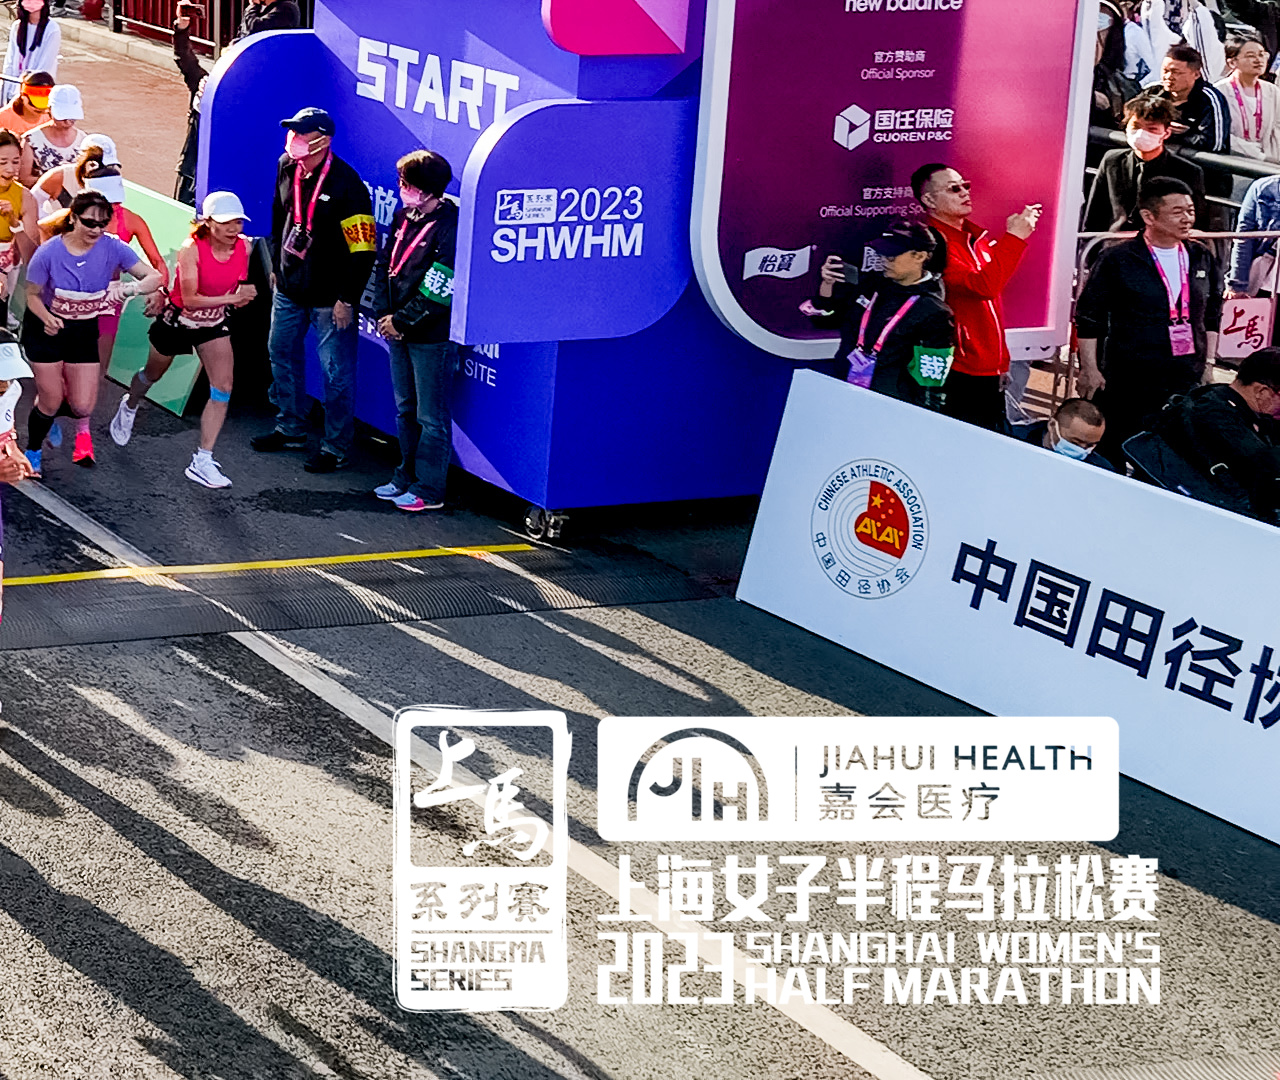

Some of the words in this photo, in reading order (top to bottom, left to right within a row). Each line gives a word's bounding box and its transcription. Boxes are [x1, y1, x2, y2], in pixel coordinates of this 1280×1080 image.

[873, 50, 926, 64] 官方赞助商
[356, 36, 520, 131] START
[860, 67, 894, 80] Official
[894, 67, 936, 81] Sponsor
[874, 108, 955, 131] 国任保险
[872, 130, 926, 144] GUOREN
[926, 130, 953, 142] P&C
[558, 186, 643, 222] 2023
[819, 205, 853, 218] Official
[854, 203, 908, 219] Supporting
[490, 222, 644, 263] SHWHM
[464, 358, 497, 388] SITE
[817, 470, 851, 512] CHINESE
[850, 464, 895, 483] ATHLETIC
[892, 478, 925, 551] ASSOCIATION
